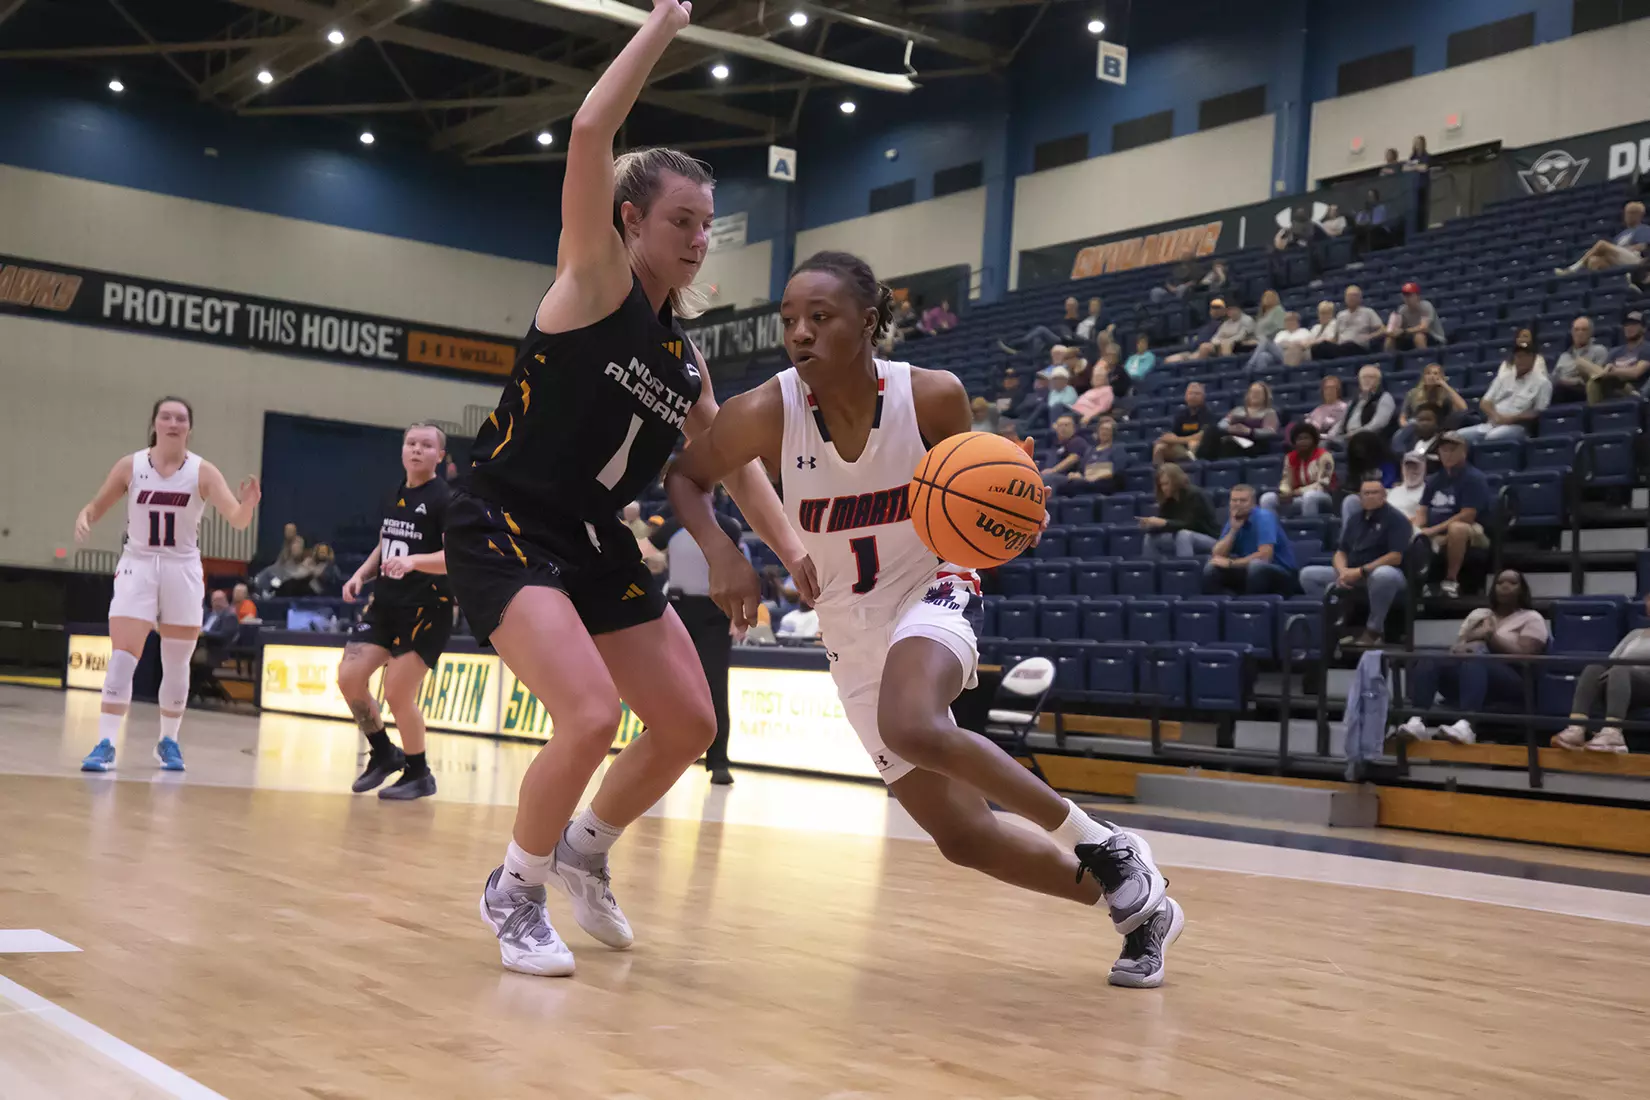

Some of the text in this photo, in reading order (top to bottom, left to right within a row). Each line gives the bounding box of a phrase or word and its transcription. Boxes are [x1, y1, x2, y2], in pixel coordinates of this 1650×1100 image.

[1104, 55, 1121, 78] B
[774, 158, 791, 176] A
[102, 281, 240, 335] PROTECT
[246, 303, 297, 345] THIS
[604, 361, 686, 431] ALABAM
[628, 356, 693, 414] NORTH
[595, 412, 645, 491] 1
[799, 483, 912, 533] UT MARTI
[1006, 479, 1044, 505] EVO
[148, 510, 176, 547] 11
[849, 535, 880, 595] 1
[417, 663, 490, 724] ARTIN
[741, 689, 784, 716] FIRST
